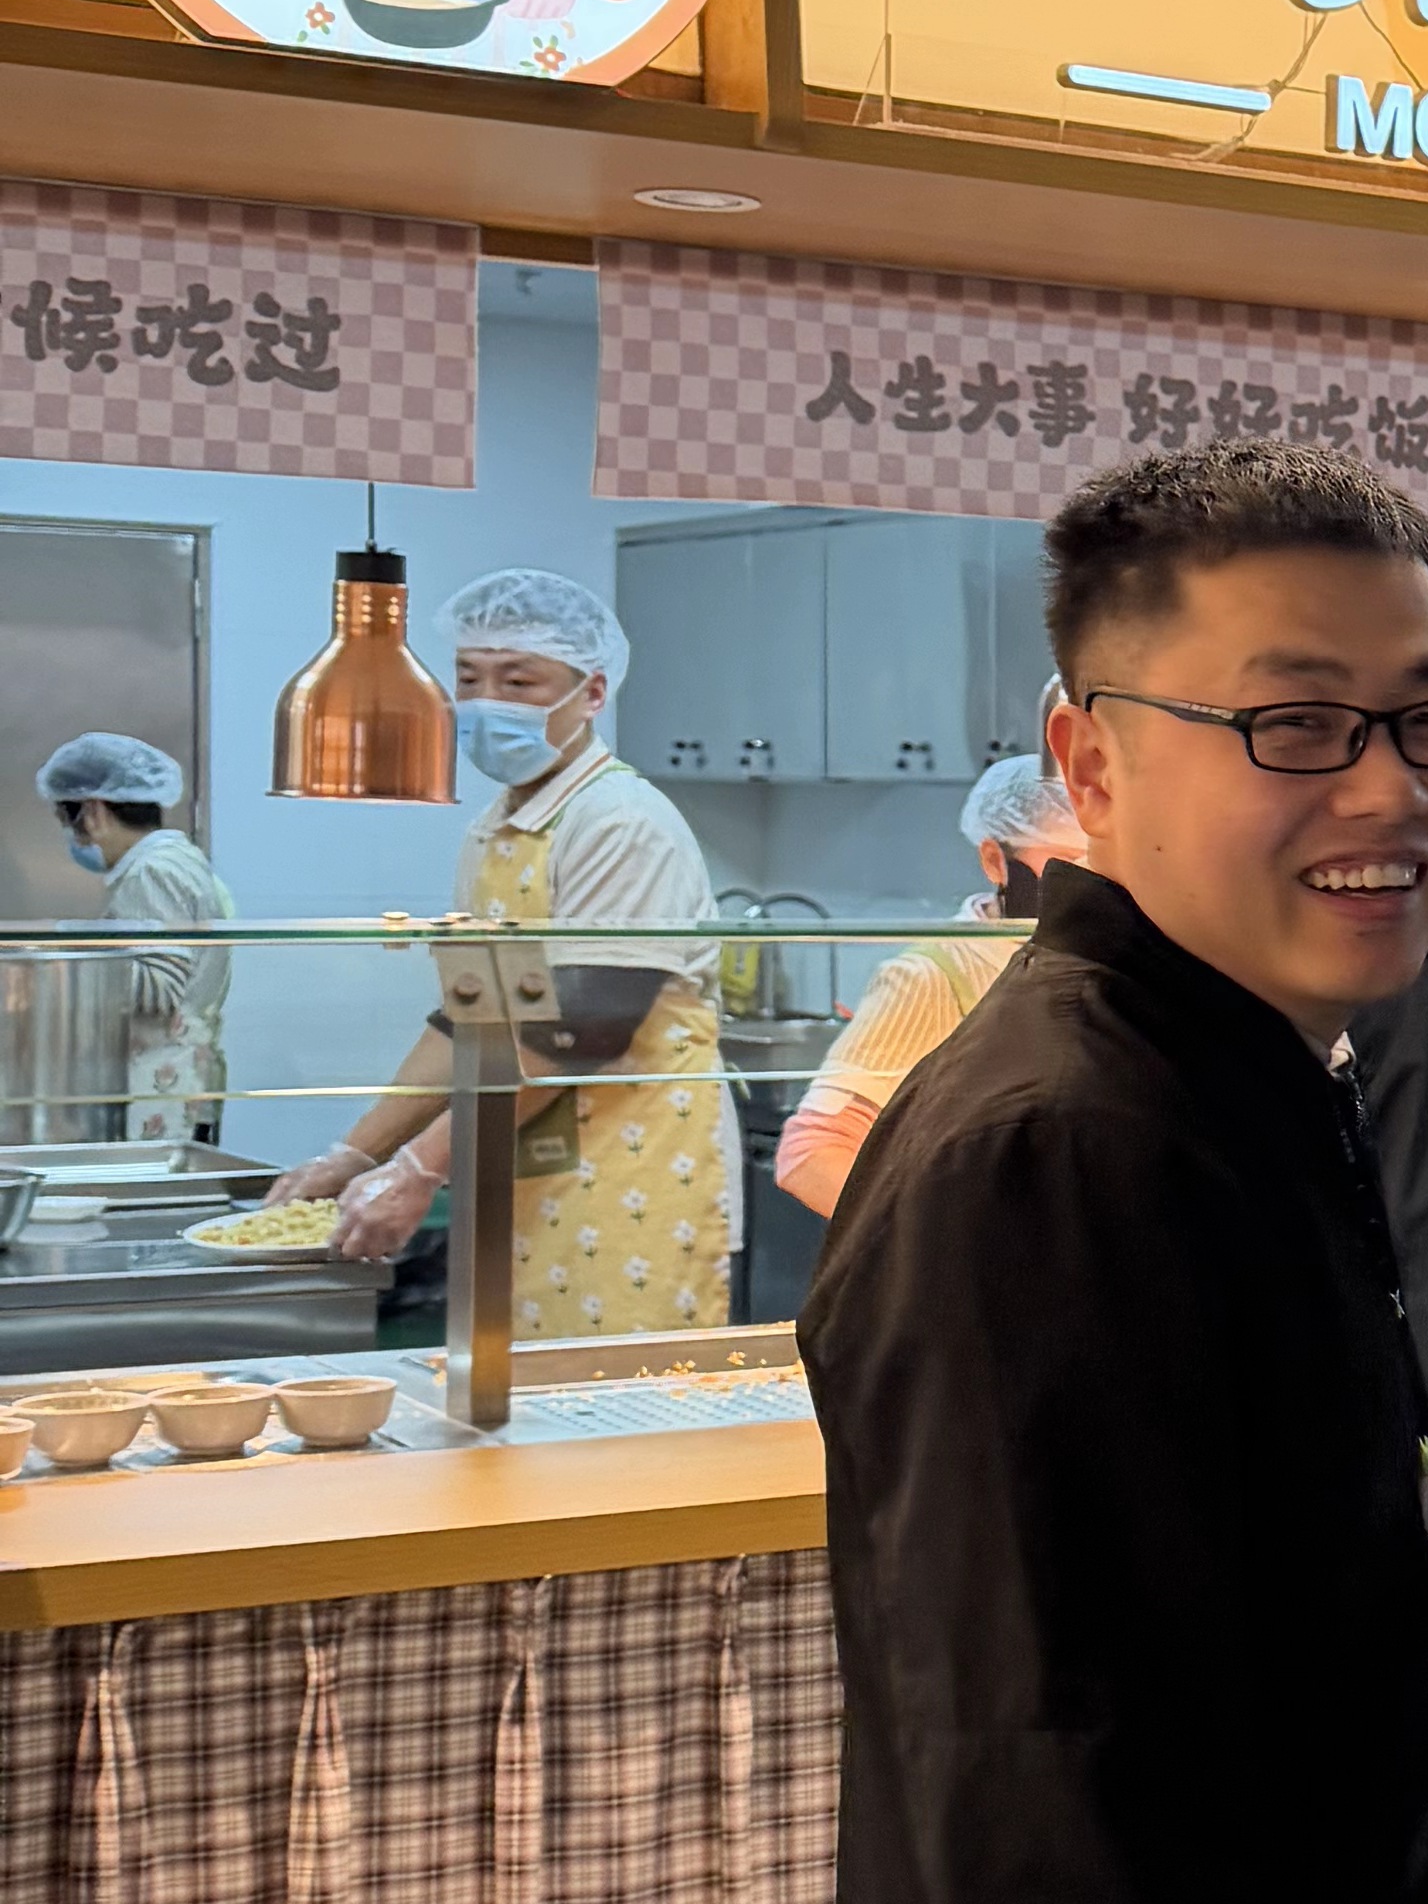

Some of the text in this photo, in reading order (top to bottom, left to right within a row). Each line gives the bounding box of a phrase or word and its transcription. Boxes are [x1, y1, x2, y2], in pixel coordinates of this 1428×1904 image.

[10, 277, 341, 392] 候吃过
[804, 350, 1096, 449] 人生大事
